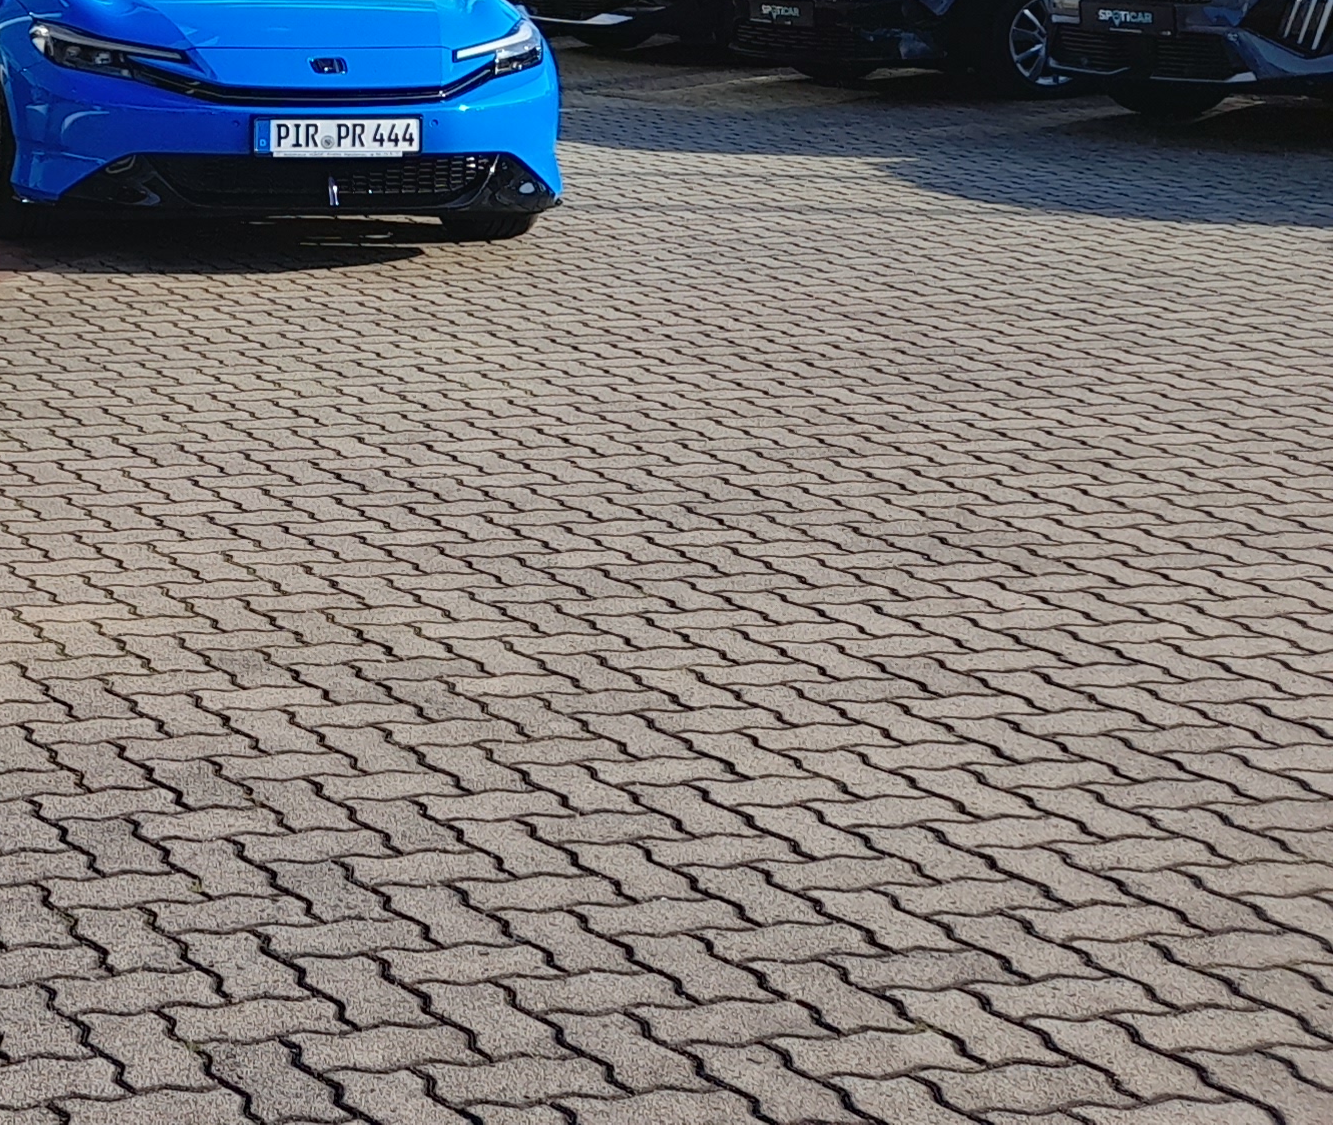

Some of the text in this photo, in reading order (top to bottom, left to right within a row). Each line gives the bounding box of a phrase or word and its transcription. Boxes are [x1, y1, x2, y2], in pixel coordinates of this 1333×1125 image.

[1098, 9, 1153, 26] SPOTICAR
[276, 123, 415, 148] PIR PR 444
